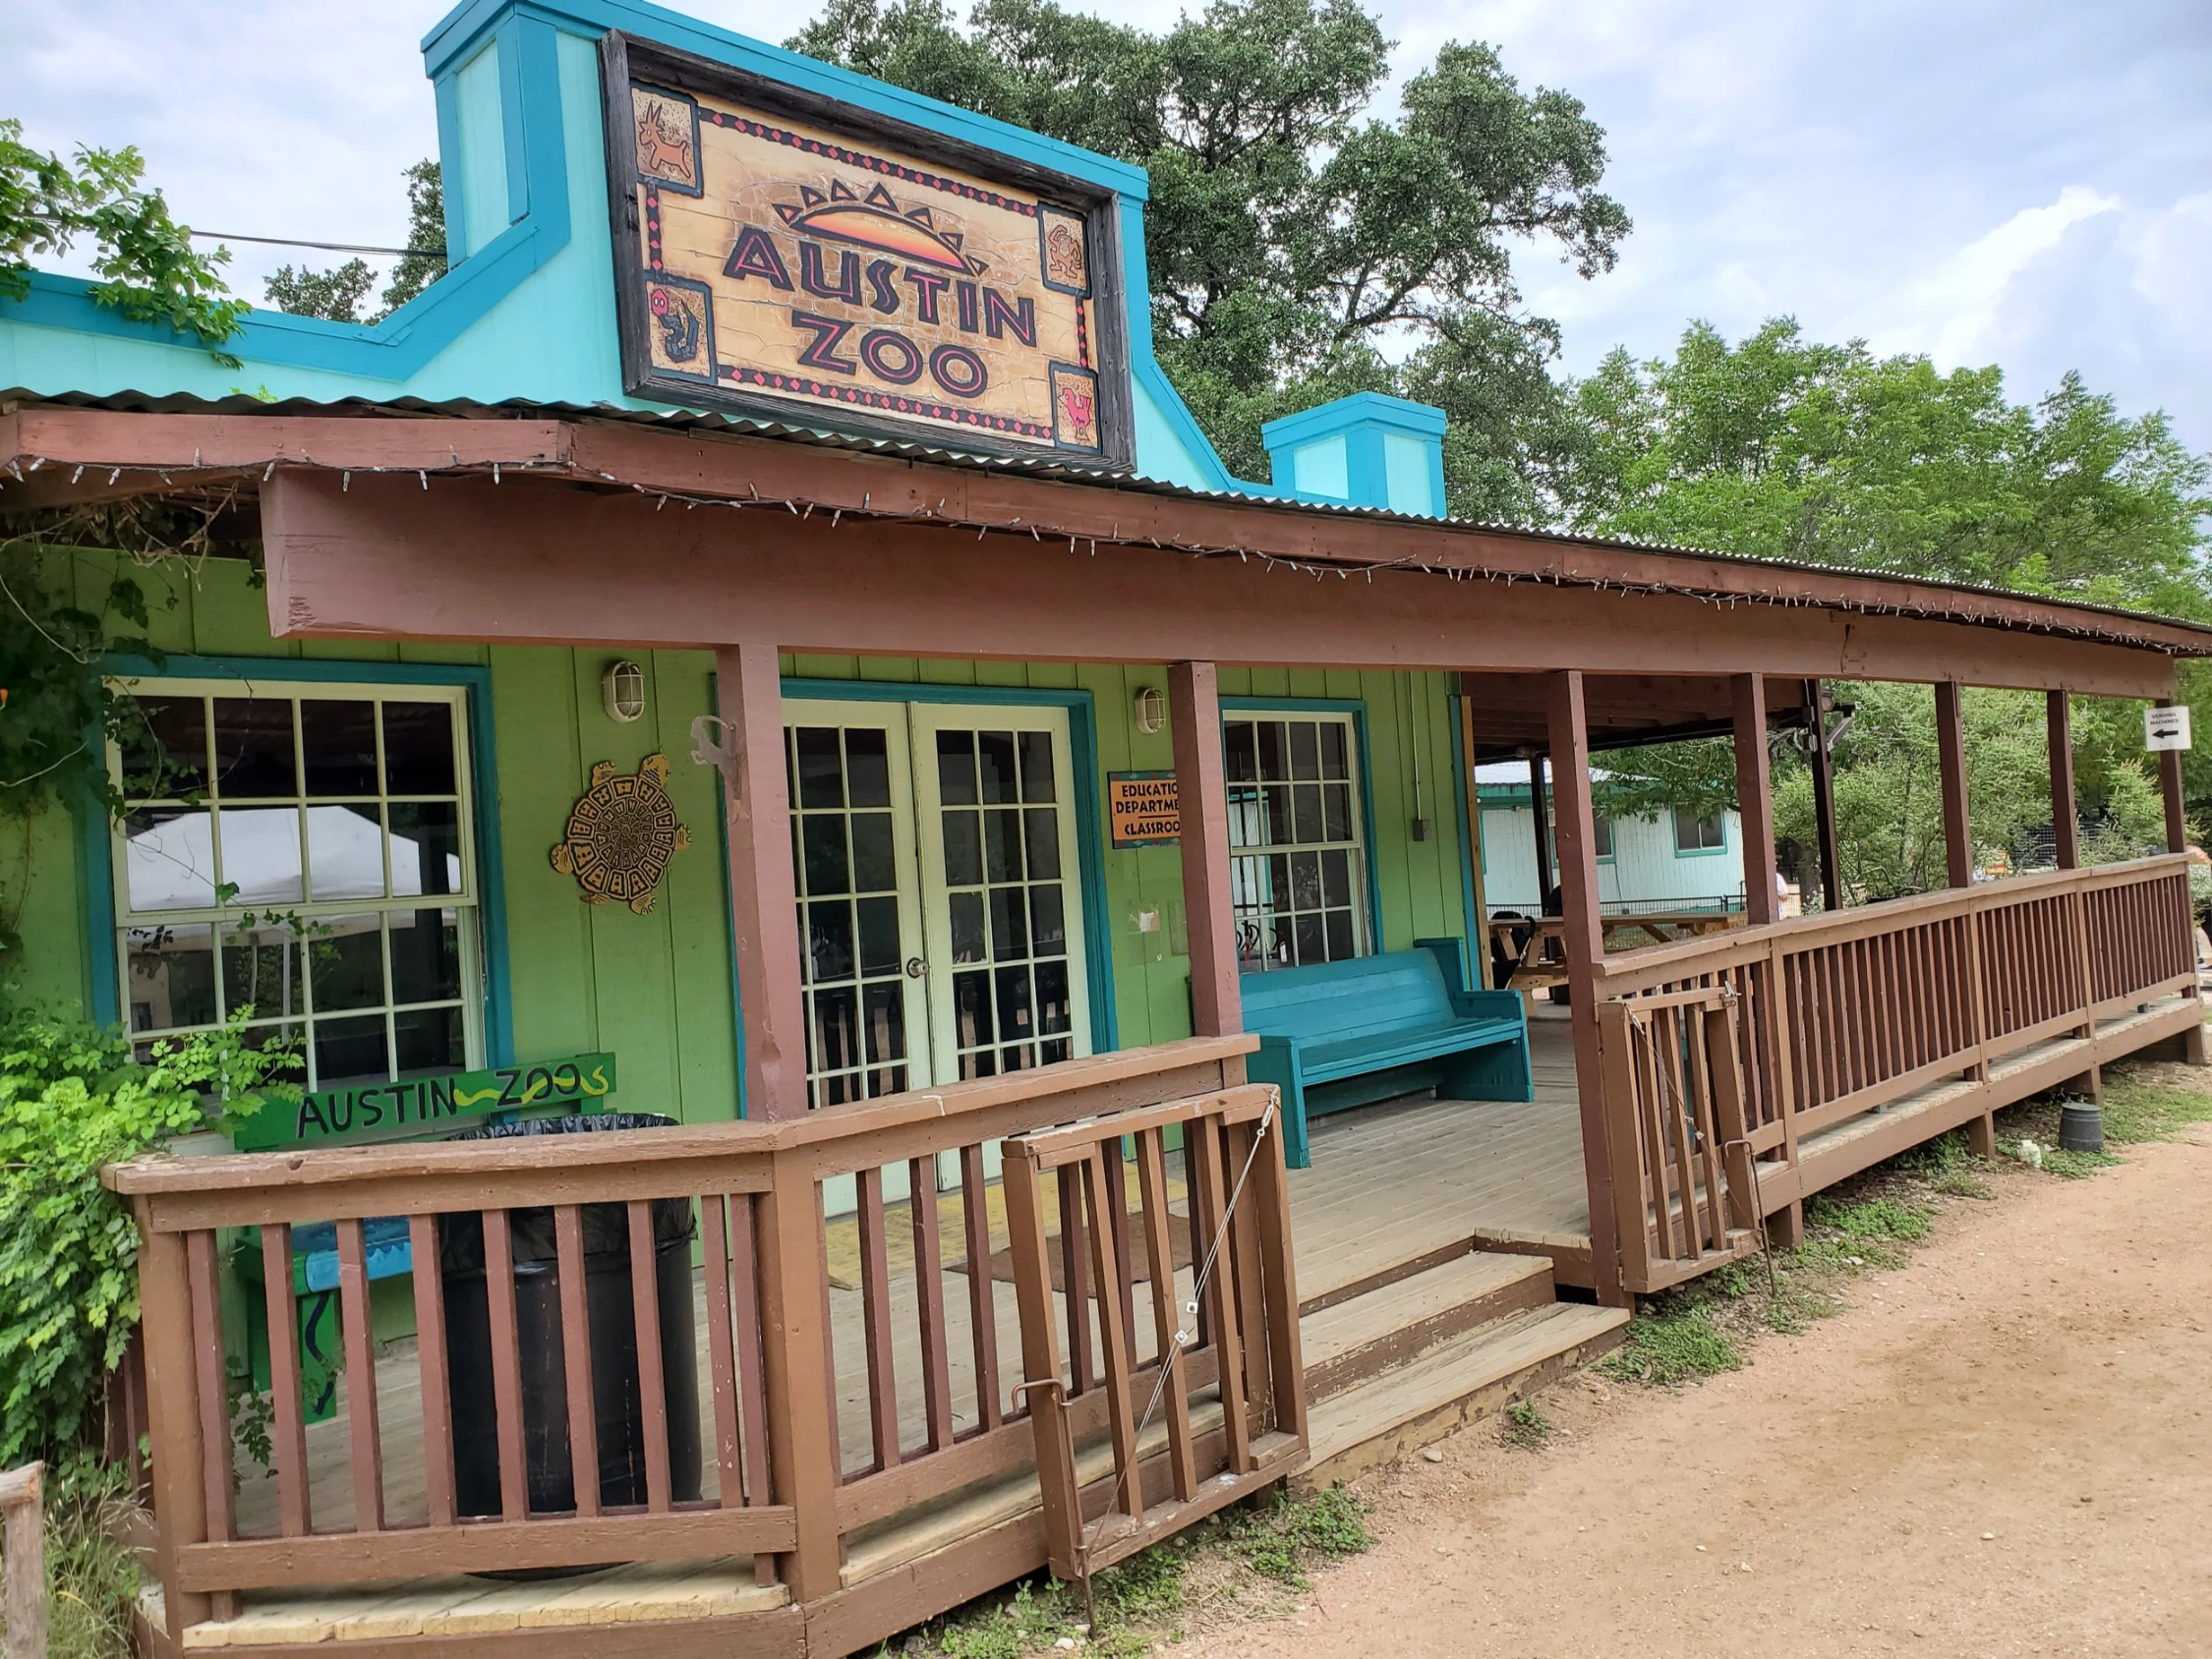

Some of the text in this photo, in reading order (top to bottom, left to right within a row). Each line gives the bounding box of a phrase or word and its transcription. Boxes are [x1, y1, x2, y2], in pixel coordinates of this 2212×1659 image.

[722, 226, 1037, 348] AUSTIN
[790, 310, 989, 398] ZOO
[1116, 798, 1180, 814] DEPARTME
[1122, 782, 1179, 797] EDUCATIO
[1124, 821, 1181, 835] CLASSROO
[297, 1063, 581, 1138] AUSTIN ZOO
